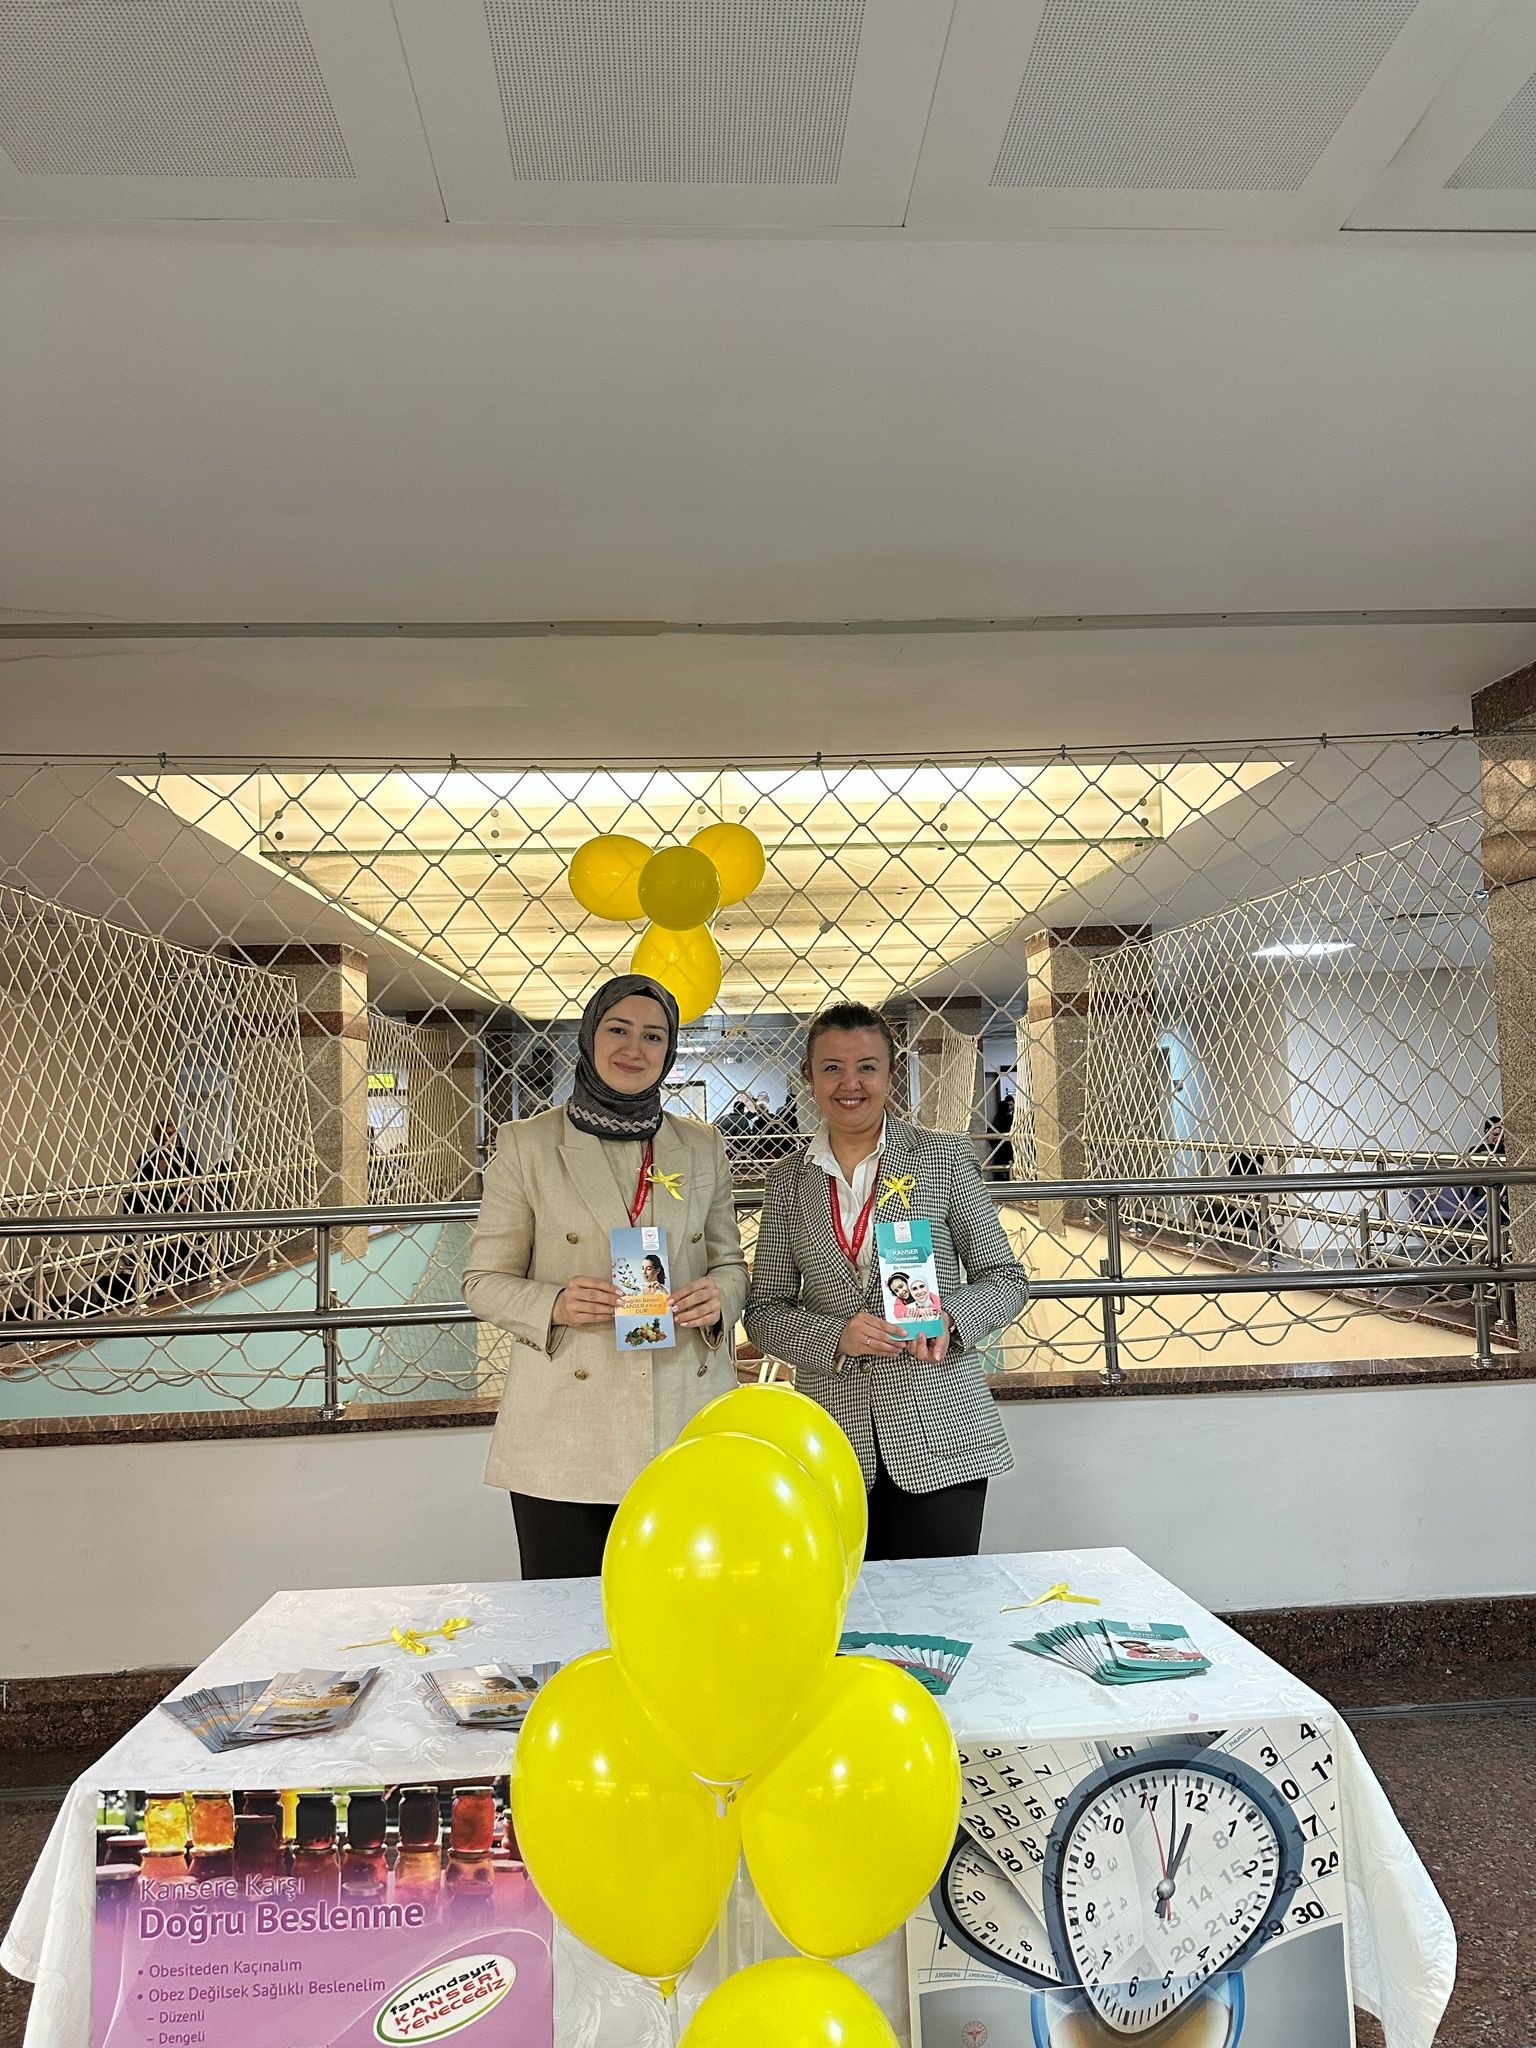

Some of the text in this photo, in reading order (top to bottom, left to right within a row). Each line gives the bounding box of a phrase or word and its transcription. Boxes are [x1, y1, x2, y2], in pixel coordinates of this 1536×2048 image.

[1300, 1723, 1317, 1740] 4
[1260, 1747, 1279, 1767] 3
[999, 1765, 1024, 1788] 14
[1034, 1764, 1052, 1776] 7
[966, 1775, 996, 1797] 21
[1024, 1796, 1047, 1820] 15
[1138, 1794, 1158, 1811] 11
[1185, 1790, 1209, 1812] 12
[992, 1804, 1020, 1829] 22
[1103, 1814, 1124, 1834] 10
[965, 1815, 996, 1839] 29
[1228, 1820, 1237, 1837] 1
[997, 1847, 1023, 1872] 30
[1020, 1837, 1044, 1862] 23
[1084, 1852, 1095, 1869] 9
[1243, 1860, 1258, 1878] 2
[141, 1874, 305, 1901] Kansere Karşı
[966, 1890, 986, 1905] 10
[1086, 1902, 1095, 1922] 8
[1230, 1909, 1243, 1925] 3
[1292, 1901, 1324, 1924] 30
[140, 1901, 424, 1944] Doğru Beslenme
[985, 1921, 999, 1933] 9
[1020, 1940, 1033, 1952] 8
[1197, 1946, 1210, 1961] 4
[149, 1959, 302, 1978] Obesiteden Kaçınalım
[1101, 1950, 1112, 1970] 7
[389, 1959, 498, 2015] farkındayız
[1129, 1976, 1139, 1997] 6
[1162, 1970, 1174, 1989] 5
[149, 1978, 386, 2002] Obez Değilsek Sağlıklı Beslenelim
[159, 2010, 205, 2023] Düzenli
[159, 2031, 206, 2046] Dengeli
